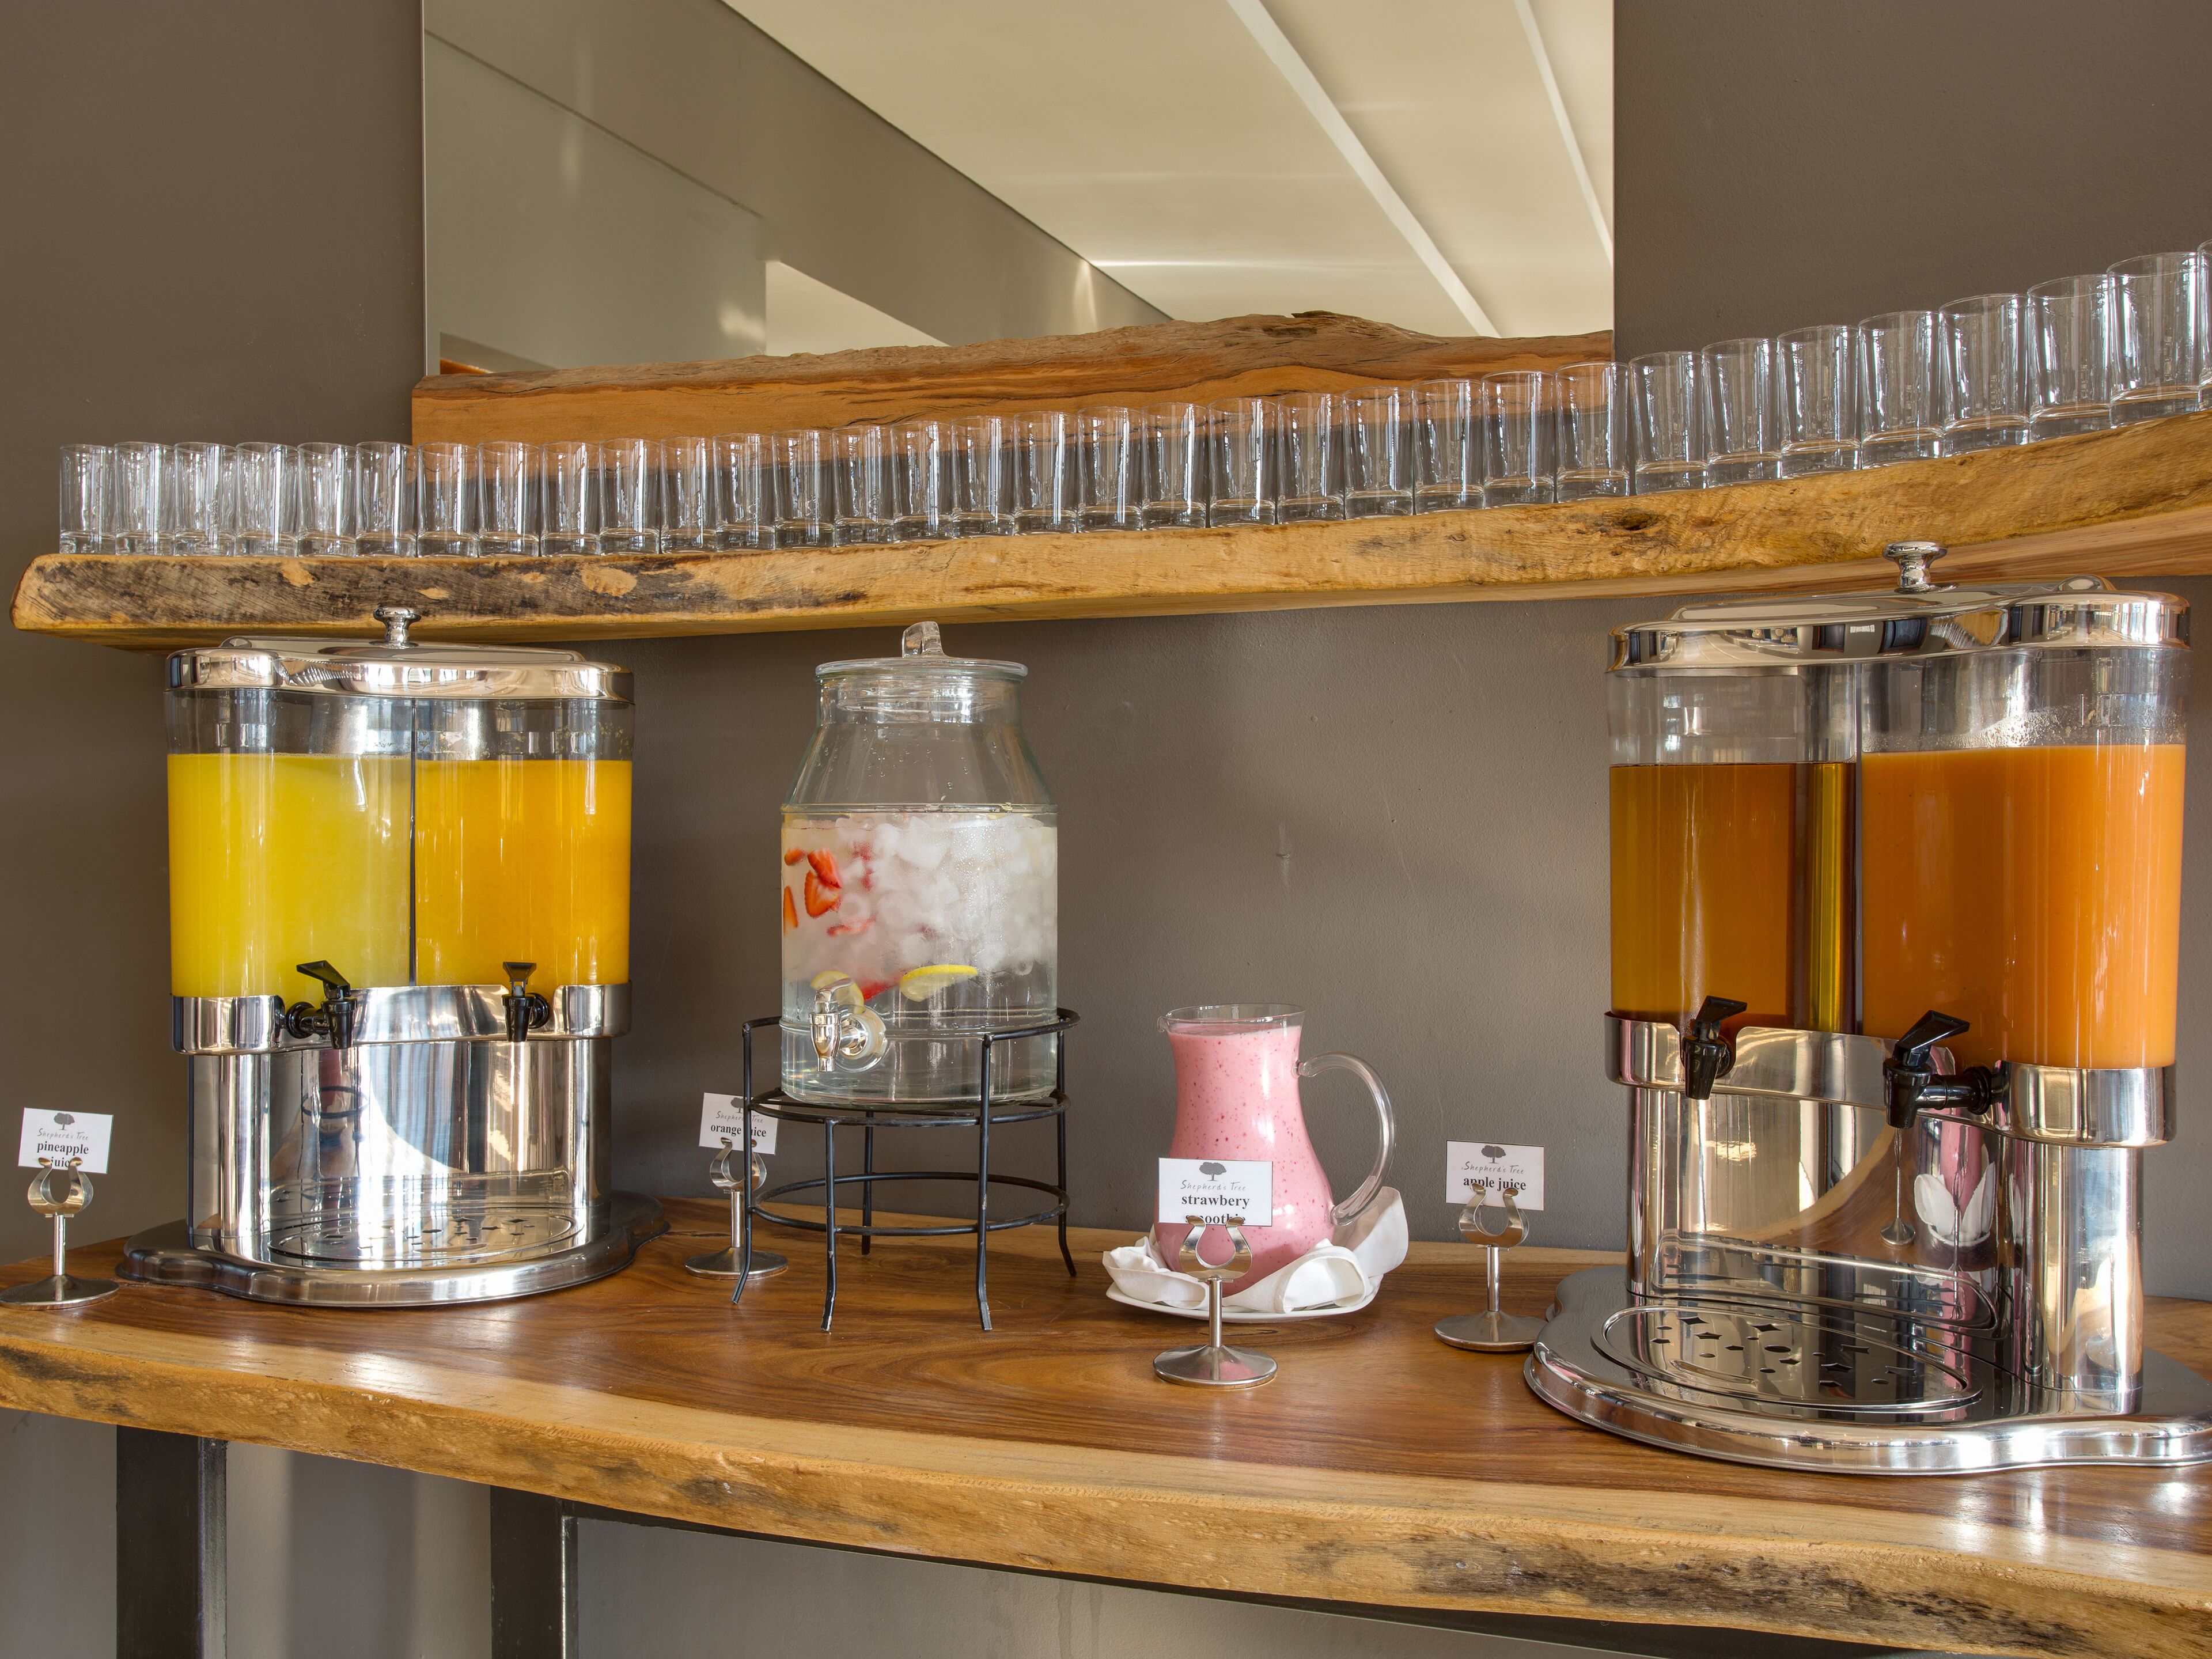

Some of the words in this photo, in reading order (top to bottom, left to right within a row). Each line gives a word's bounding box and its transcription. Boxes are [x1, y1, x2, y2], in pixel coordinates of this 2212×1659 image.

[715, 1111, 744, 1122] Shepher
[752, 1115, 763, 1123] Tree
[37, 1128, 73, 1139] Shepherd's
[76, 1131, 88, 1141] Tree
[711, 1124, 741, 1137] orange
[751, 1127, 767, 1137] ice
[37, 1141, 89, 1156] pineapple
[51, 1156, 70, 1168] juic
[1464, 1161, 1506, 1173] Shepherd's
[1510, 1165, 1524, 1174] Tree
[1180, 1180, 1226, 1192] Shepherd's
[1230, 1181, 1246, 1191] Tree
[1497, 1177, 1526, 1191] juice
[1181, 1195, 1250, 1209] strawbery
